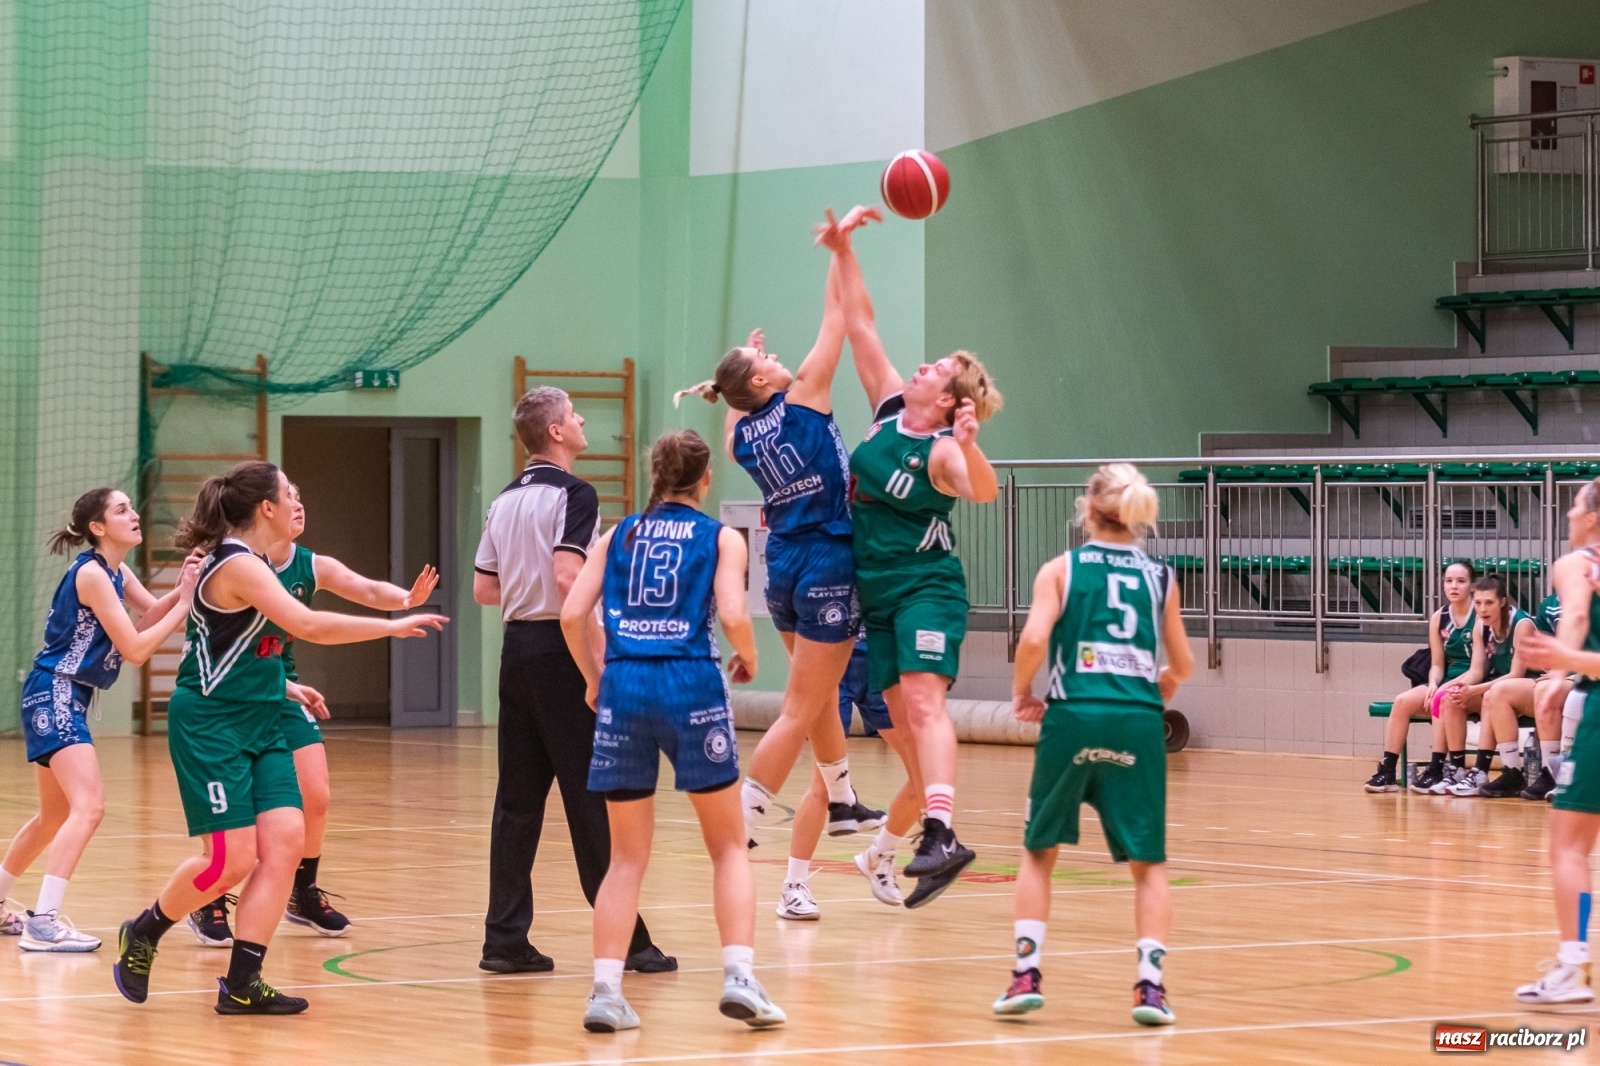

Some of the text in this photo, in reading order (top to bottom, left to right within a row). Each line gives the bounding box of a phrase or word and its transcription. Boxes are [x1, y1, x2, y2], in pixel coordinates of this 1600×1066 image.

[885, 469, 914, 499] 10
[628, 540, 682, 607] 13
[1106, 573, 1140, 639] 5
[619, 619, 690, 633] PROTECH
[207, 781, 228, 814] 9
